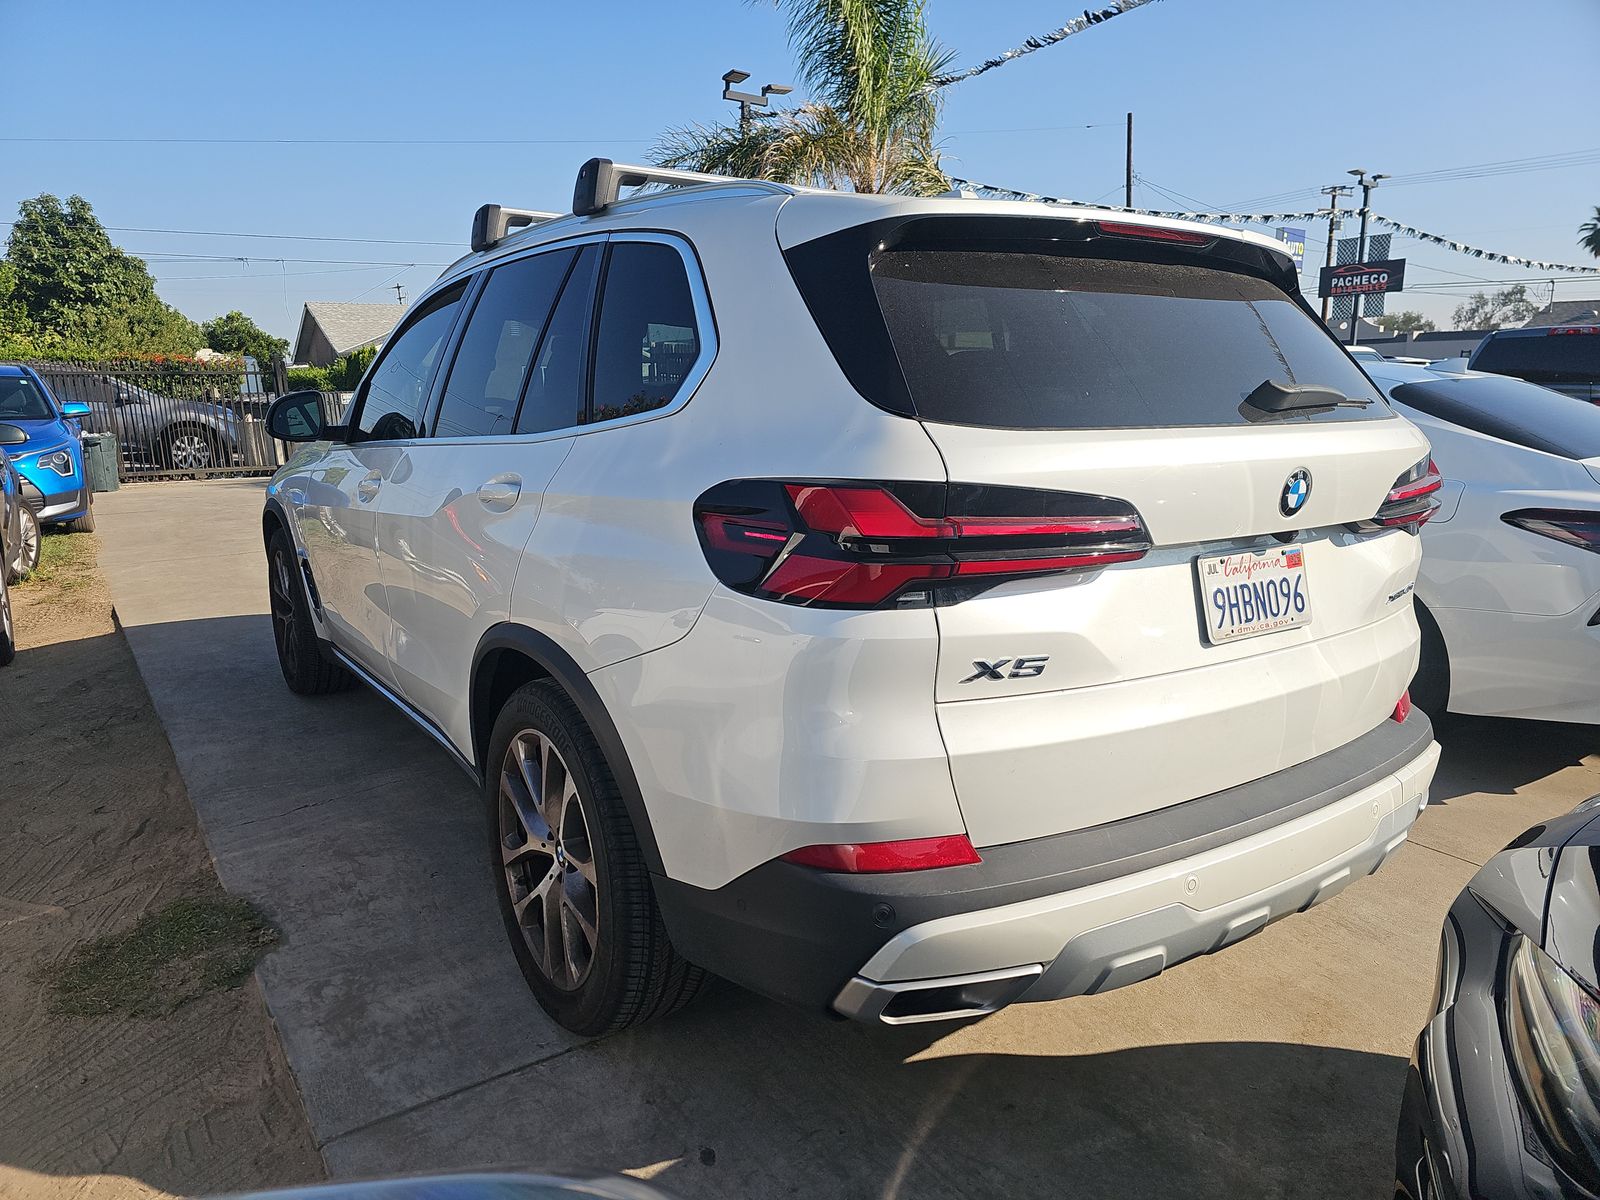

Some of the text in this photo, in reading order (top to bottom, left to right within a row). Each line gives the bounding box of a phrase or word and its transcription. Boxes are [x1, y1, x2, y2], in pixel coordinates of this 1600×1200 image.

[1331, 273, 1389, 287] PACHECO
[1330, 283, 1387, 294] AUTO SALES
[1207, 563, 1219, 575] JUL
[1224, 554, 1285, 580] California
[1212, 574, 1306, 629] 9HBN096
[1237, 619, 1290, 634] dmv.ca.gov
[958, 655, 1050, 684] X5
